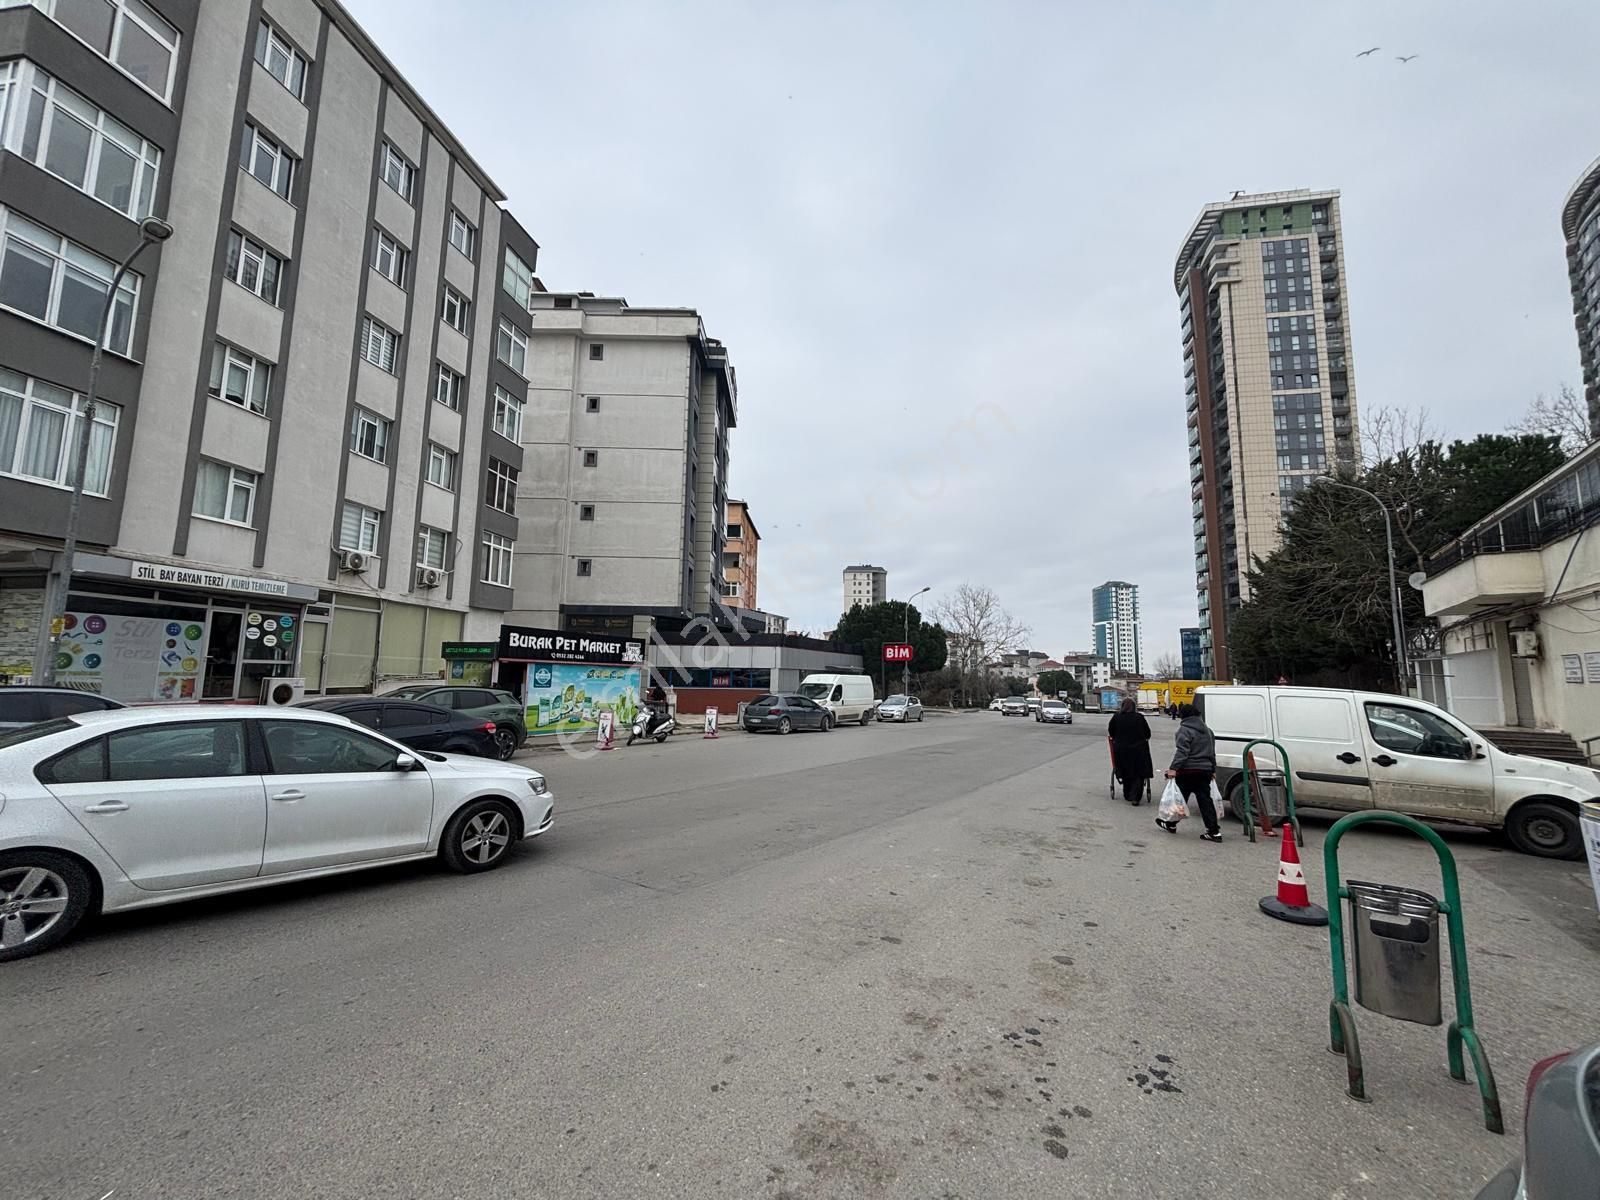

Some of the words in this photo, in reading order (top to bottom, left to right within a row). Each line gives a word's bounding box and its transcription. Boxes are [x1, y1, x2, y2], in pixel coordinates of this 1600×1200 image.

[138, 564, 155, 579] STİL
[160, 569, 176, 582] BAY
[177, 571, 202, 584] BAYAN
[204, 574, 224, 587] TERZİ
[231, 578, 250, 590] KURU
[509, 632, 553, 650] BURAK
[555, 636, 577, 651] PET
[579, 638, 621, 654] MARKET
[886, 645, 909, 658] BİM
